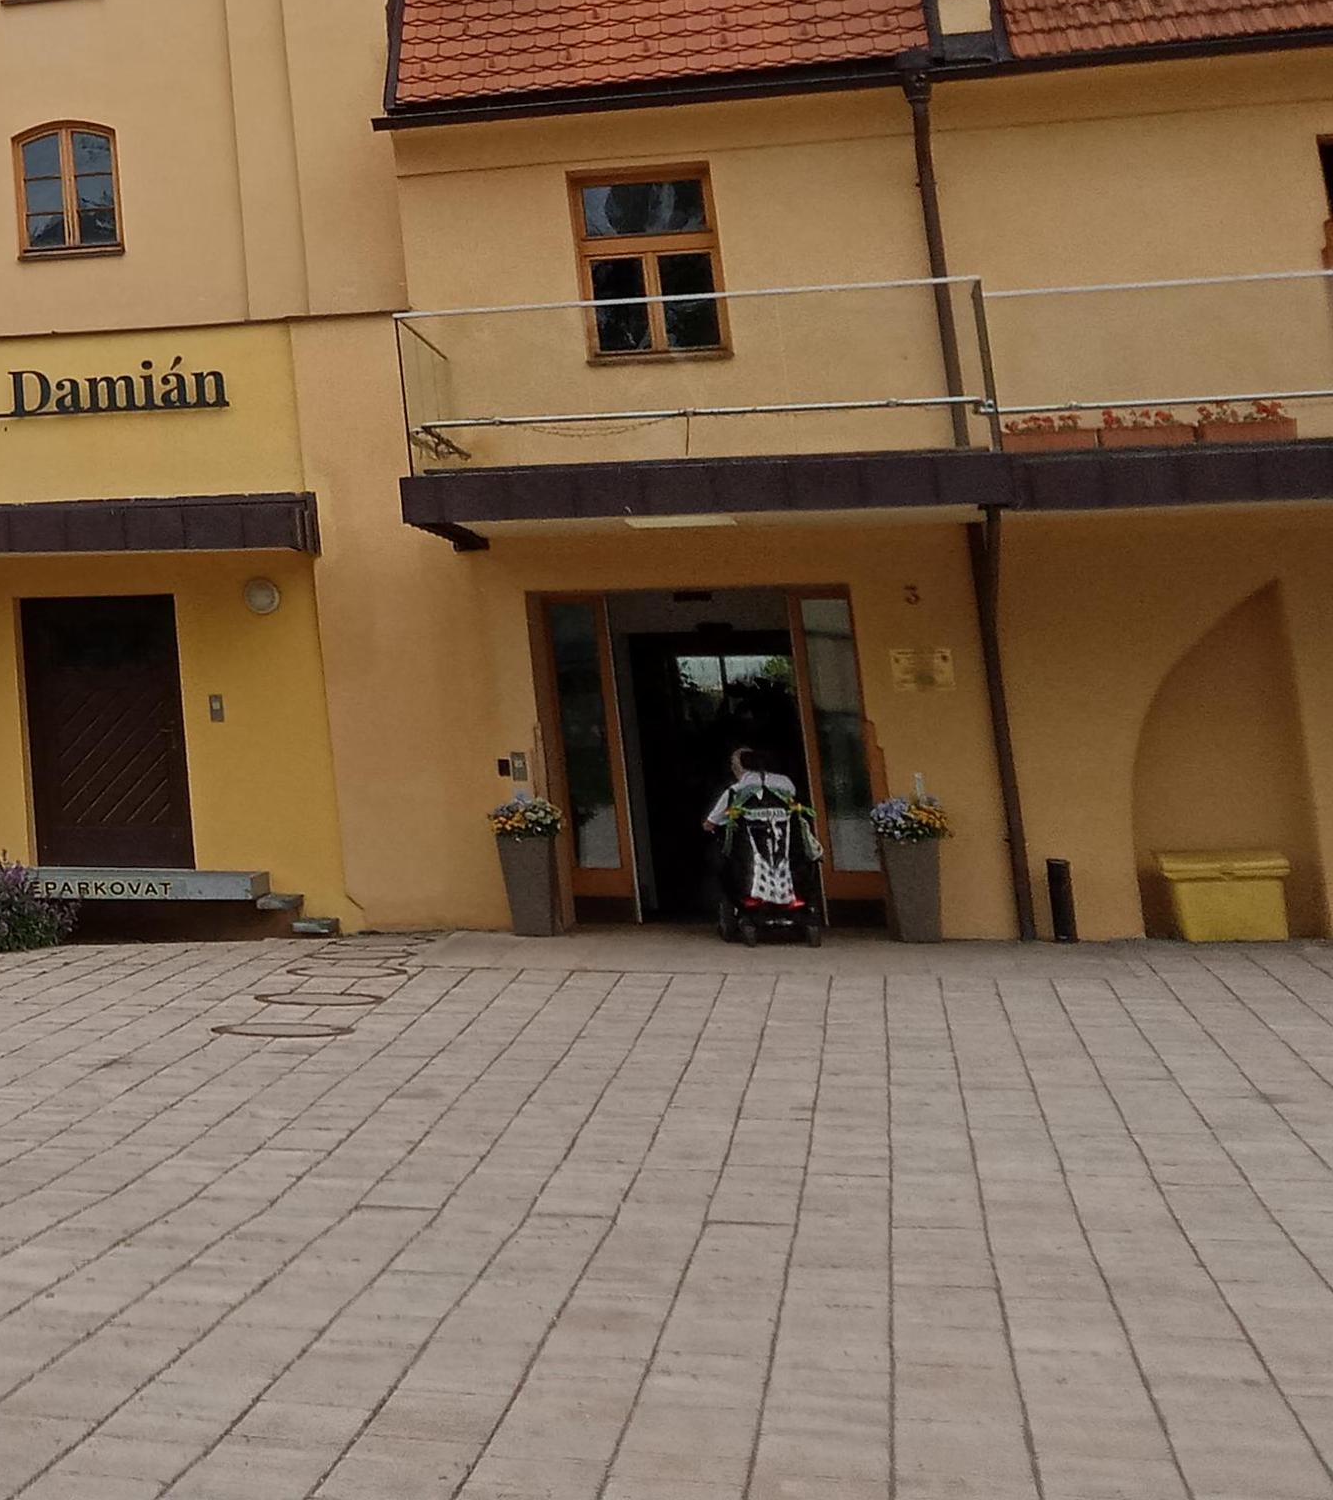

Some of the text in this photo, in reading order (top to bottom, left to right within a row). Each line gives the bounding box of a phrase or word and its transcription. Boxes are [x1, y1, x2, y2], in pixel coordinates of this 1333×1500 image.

[8, 356, 230, 416] Damián
[903, 585, 920, 605] 3
[30, 881, 172, 897] EPARKOVAT
